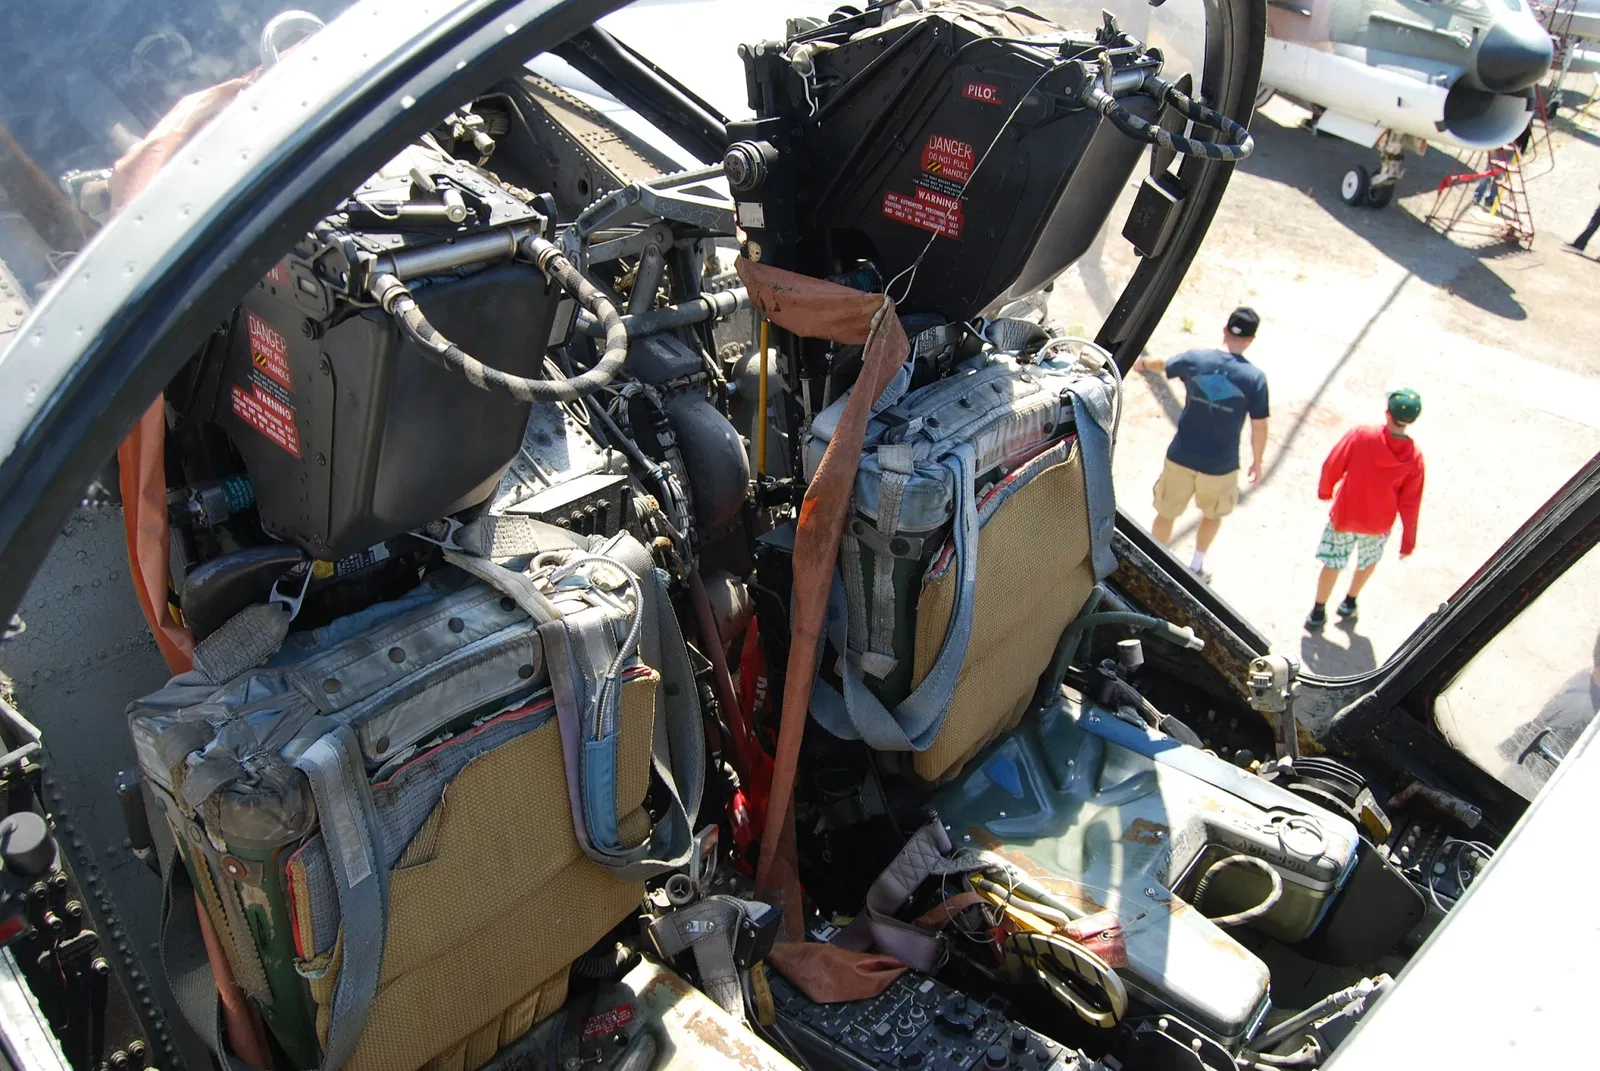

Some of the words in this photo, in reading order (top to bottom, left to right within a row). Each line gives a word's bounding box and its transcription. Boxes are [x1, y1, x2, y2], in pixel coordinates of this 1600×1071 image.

[929, 134, 972, 160] DANGER
[928, 152, 938, 160] DO
[938, 156, 951, 165] NOT
[953, 158, 969, 170] PULL
[942, 166, 969, 180] HANDLE
[918, 190, 958, 210] WARNING
[948, 213, 958, 222] MAY
[249, 315, 288, 356] DANGER
[253, 338, 260, 350] DO
[261, 344, 273, 358] NOT
[274, 353, 289, 371] PULL
[267, 360, 291, 384] HANDLE
[256, 389, 291, 420] WARNING
